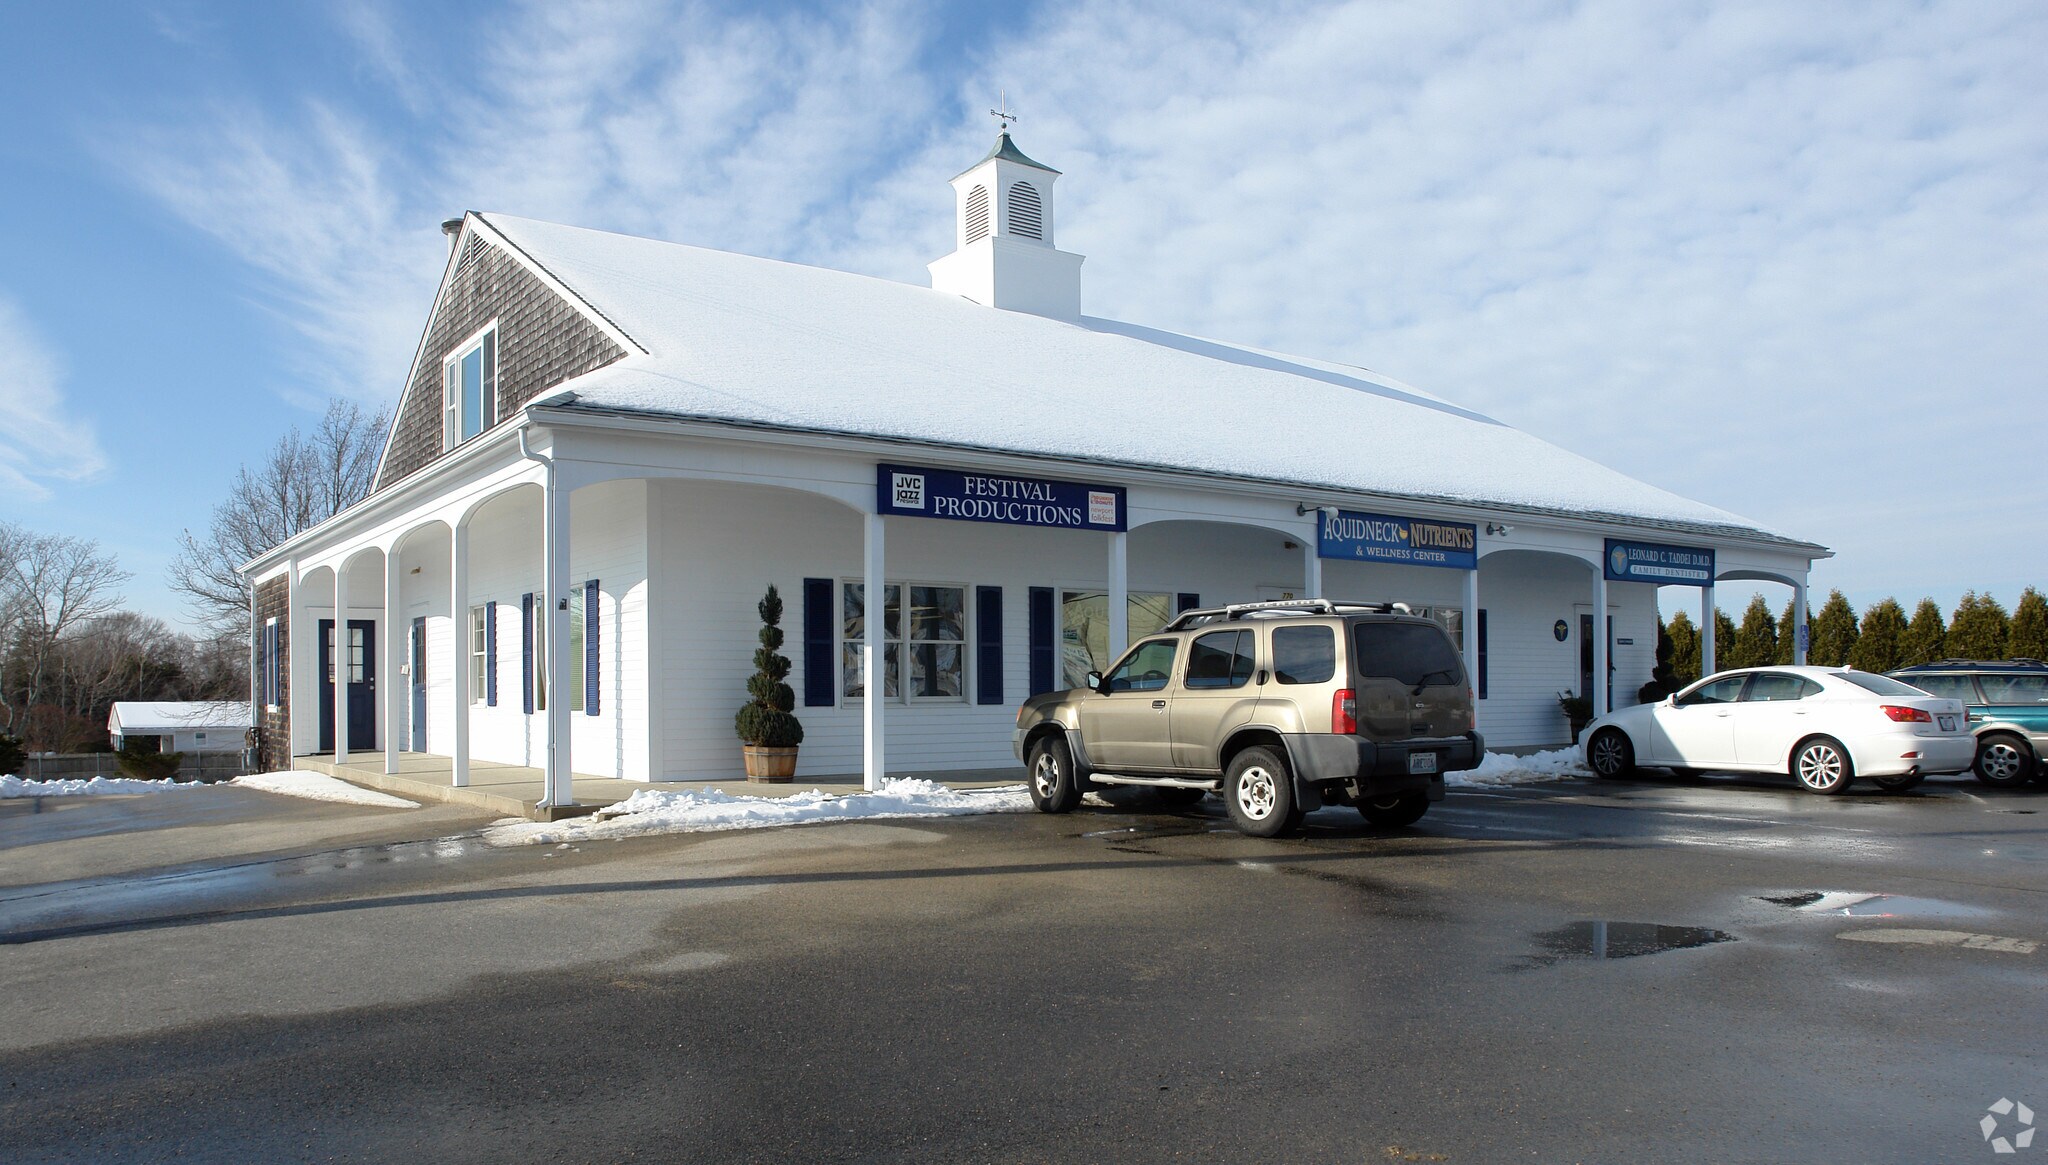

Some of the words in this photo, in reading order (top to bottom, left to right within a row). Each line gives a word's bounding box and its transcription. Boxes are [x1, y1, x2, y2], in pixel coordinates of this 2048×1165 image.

[896, 477, 921, 489] JVC
[963, 476, 1056, 501] FESTIVAL
[896, 490, 920, 501] jazz
[933, 496, 1082, 525] PRODUCTIONS
[1324, 517, 1400, 543] AQUIDNECK
[1410, 523, 1474, 549] NUTRIENTS
[1356, 545, 1364, 556] &
[1366, 546, 1411, 559] WELLNESS
[1413, 550, 1446, 562] CENTER
[1628, 548, 1659, 562] LEONARD
[1660, 551, 1667, 563] C.
[1669, 552, 1691, 565] TADDEI
[1692, 554, 1711, 567] D.M.D.
[1633, 565, 1660, 575] FAMILY
[1665, 568, 1705, 579] DENTISTRY
